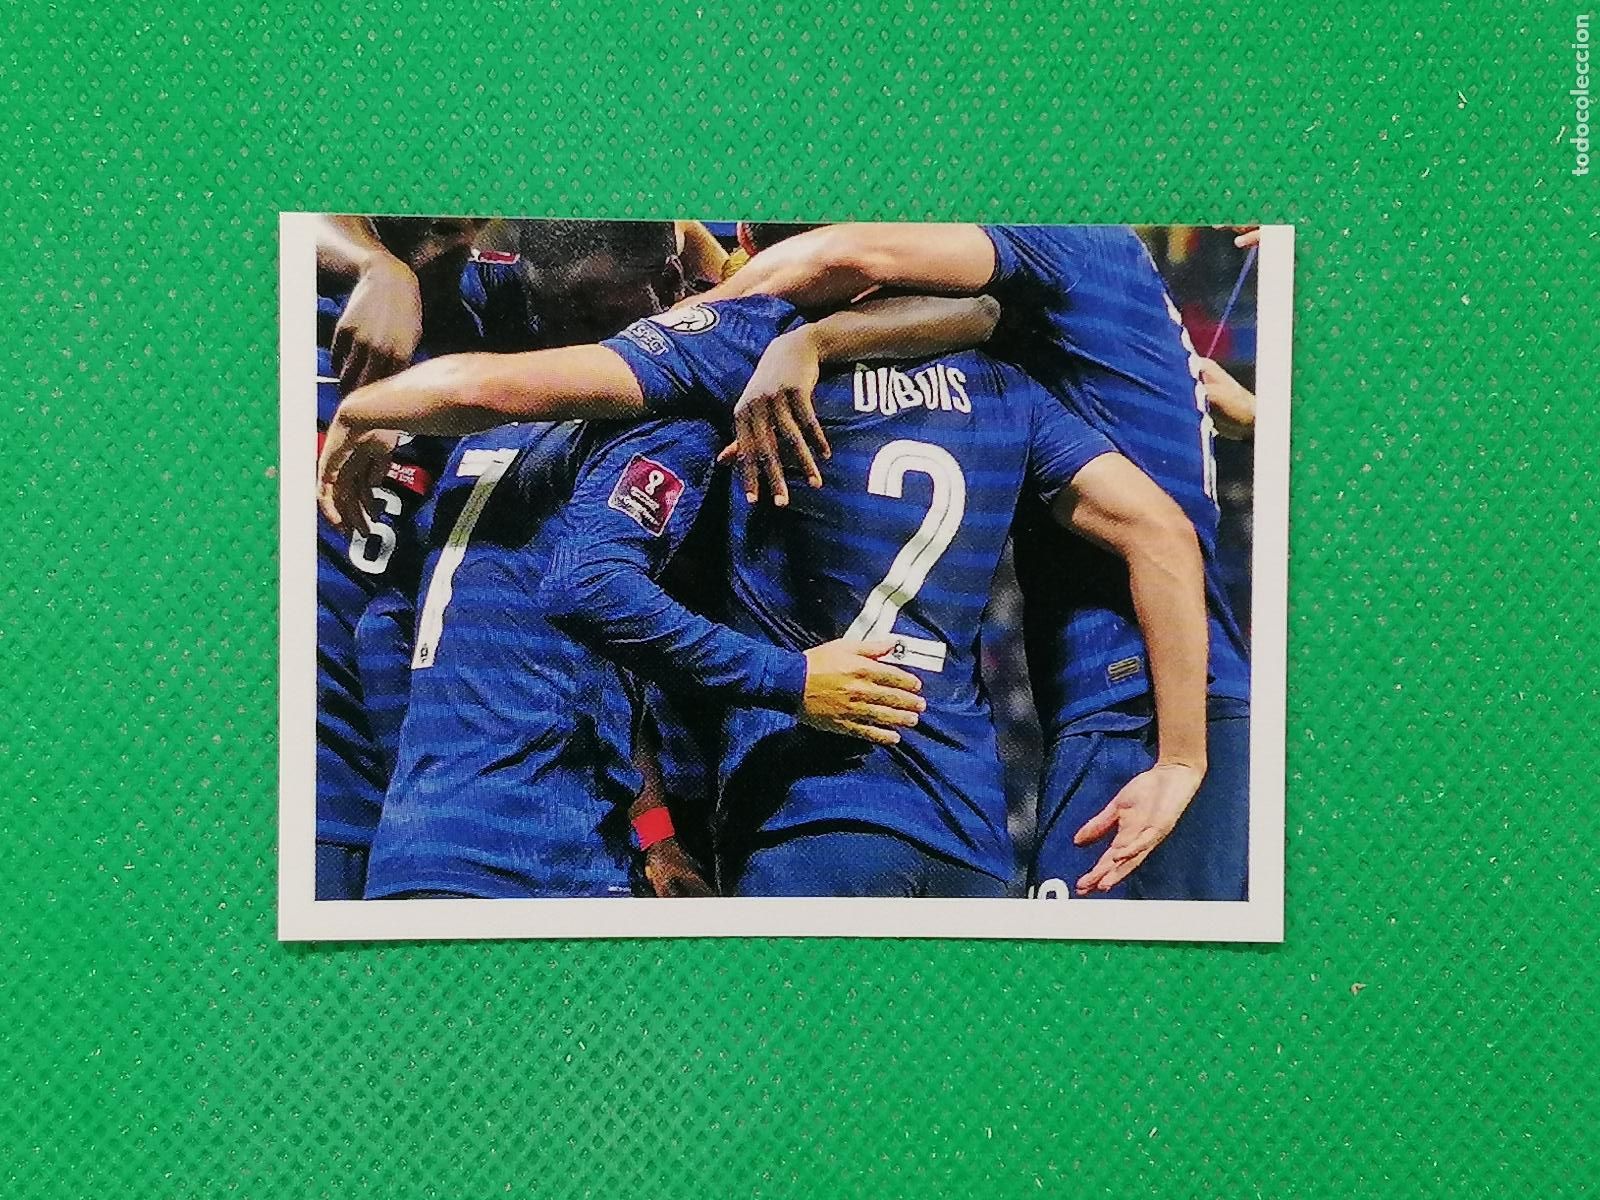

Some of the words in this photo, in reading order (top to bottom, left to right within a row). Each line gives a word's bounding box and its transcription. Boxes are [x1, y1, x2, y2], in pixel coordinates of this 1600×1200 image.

[853, 363, 972, 416] DUBOIS
[411, 448, 520, 670] 7
[843, 439, 967, 673] 2
